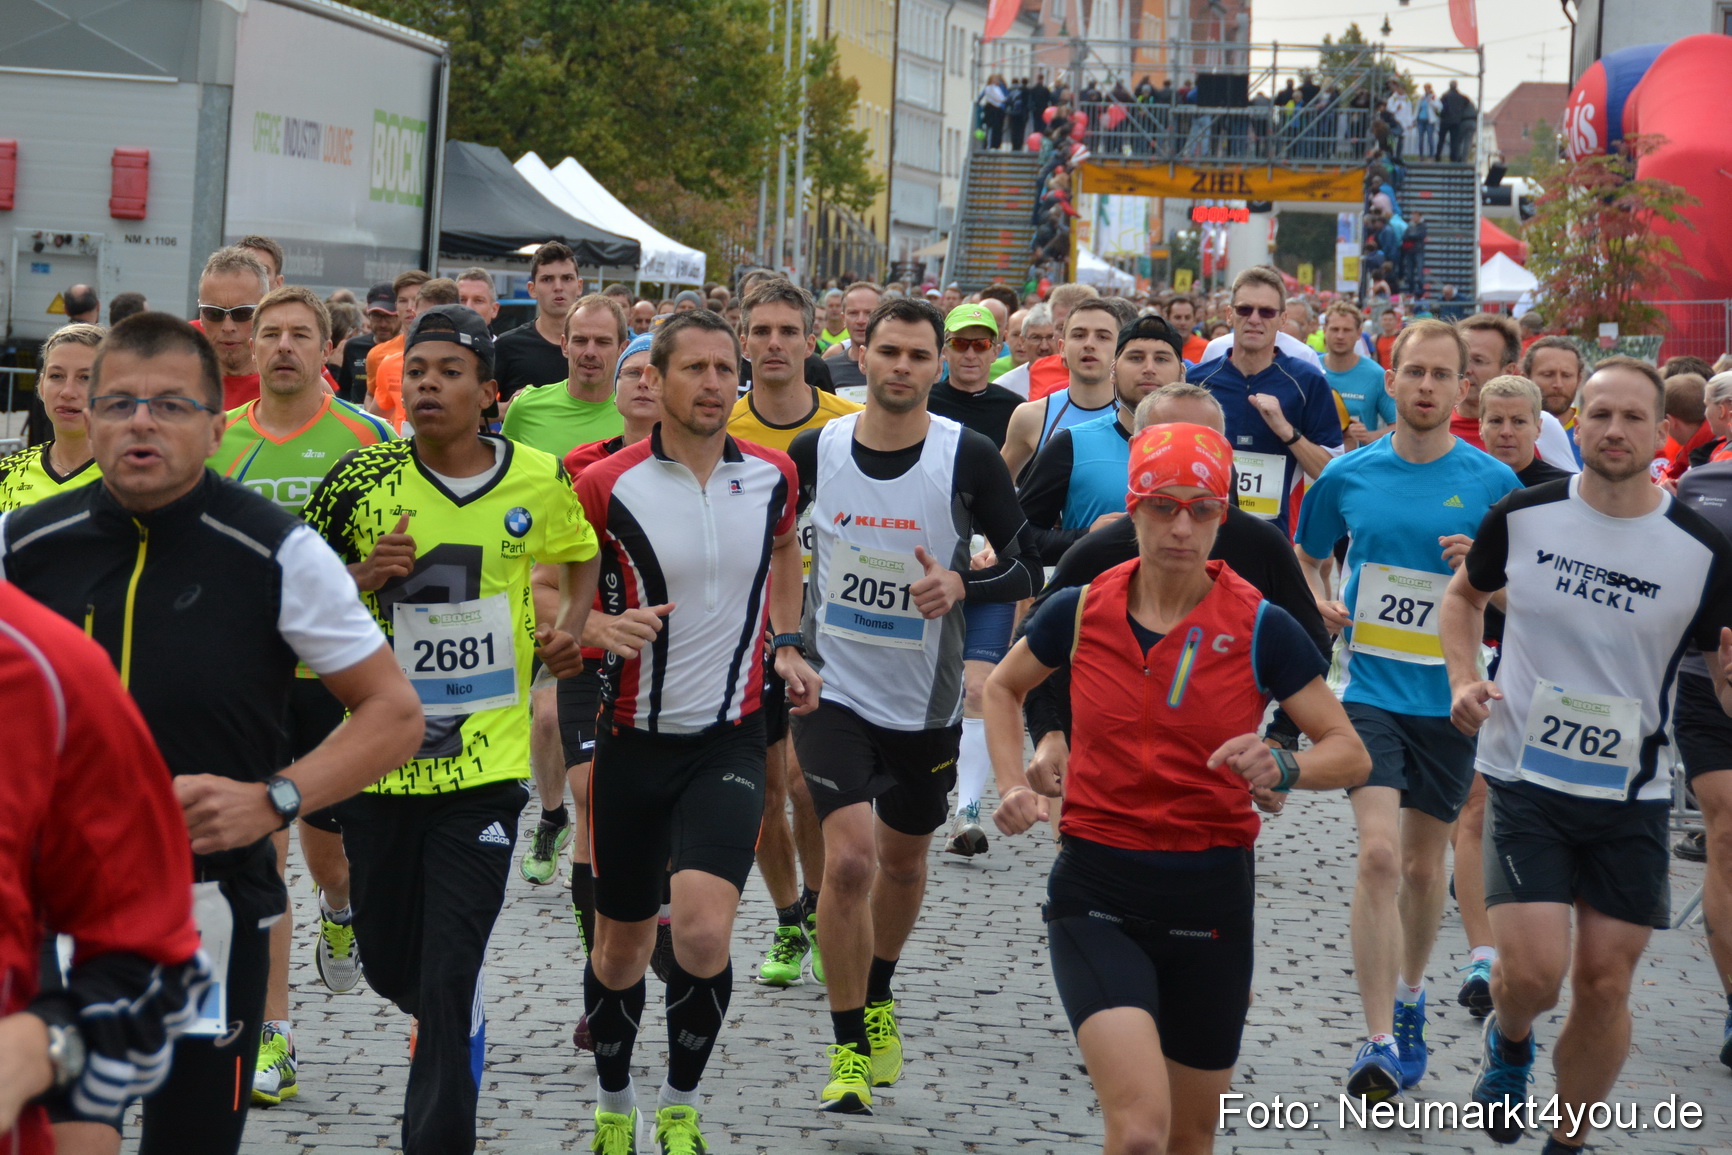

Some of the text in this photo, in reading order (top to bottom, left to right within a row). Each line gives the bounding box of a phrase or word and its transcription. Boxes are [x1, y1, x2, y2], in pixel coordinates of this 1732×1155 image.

[253, 111, 354, 166] OFFICE INDUSTRY LOUNGE
[370, 108, 427, 208] BOCK
[1190, 171, 1253, 195] ZIEL
[124, 234, 142, 244] NM
[154, 236, 178, 247] 1106
[1237, 472, 1263, 493] 51
[1239, 499, 1255, 507] artin
[855, 515, 922, 531] KLEBL
[501, 540, 526, 554] Partl
[868, 558, 904, 570] BOCK
[1398, 576, 1432, 589] BOCK
[1554, 555, 1661, 599] INTERSPORT
[840, 573, 911, 611] 2051
[1555, 575, 1635, 613] HÄCKL
[441, 610, 481, 624] BOCK
[1378, 594, 1434, 627] 287
[854, 613, 894, 630] Thomas
[413, 632, 495, 673] 2681
[446, 684, 473, 695] Nico
[1572, 699, 1611, 714] BOCK
[1540, 715, 1622, 759] 2762
[735, 776, 755, 790] asics
[479, 834, 510, 846] adidas
[1088, 910, 1123, 924] cocoon
[1169, 929, 1212, 939] cocoon
